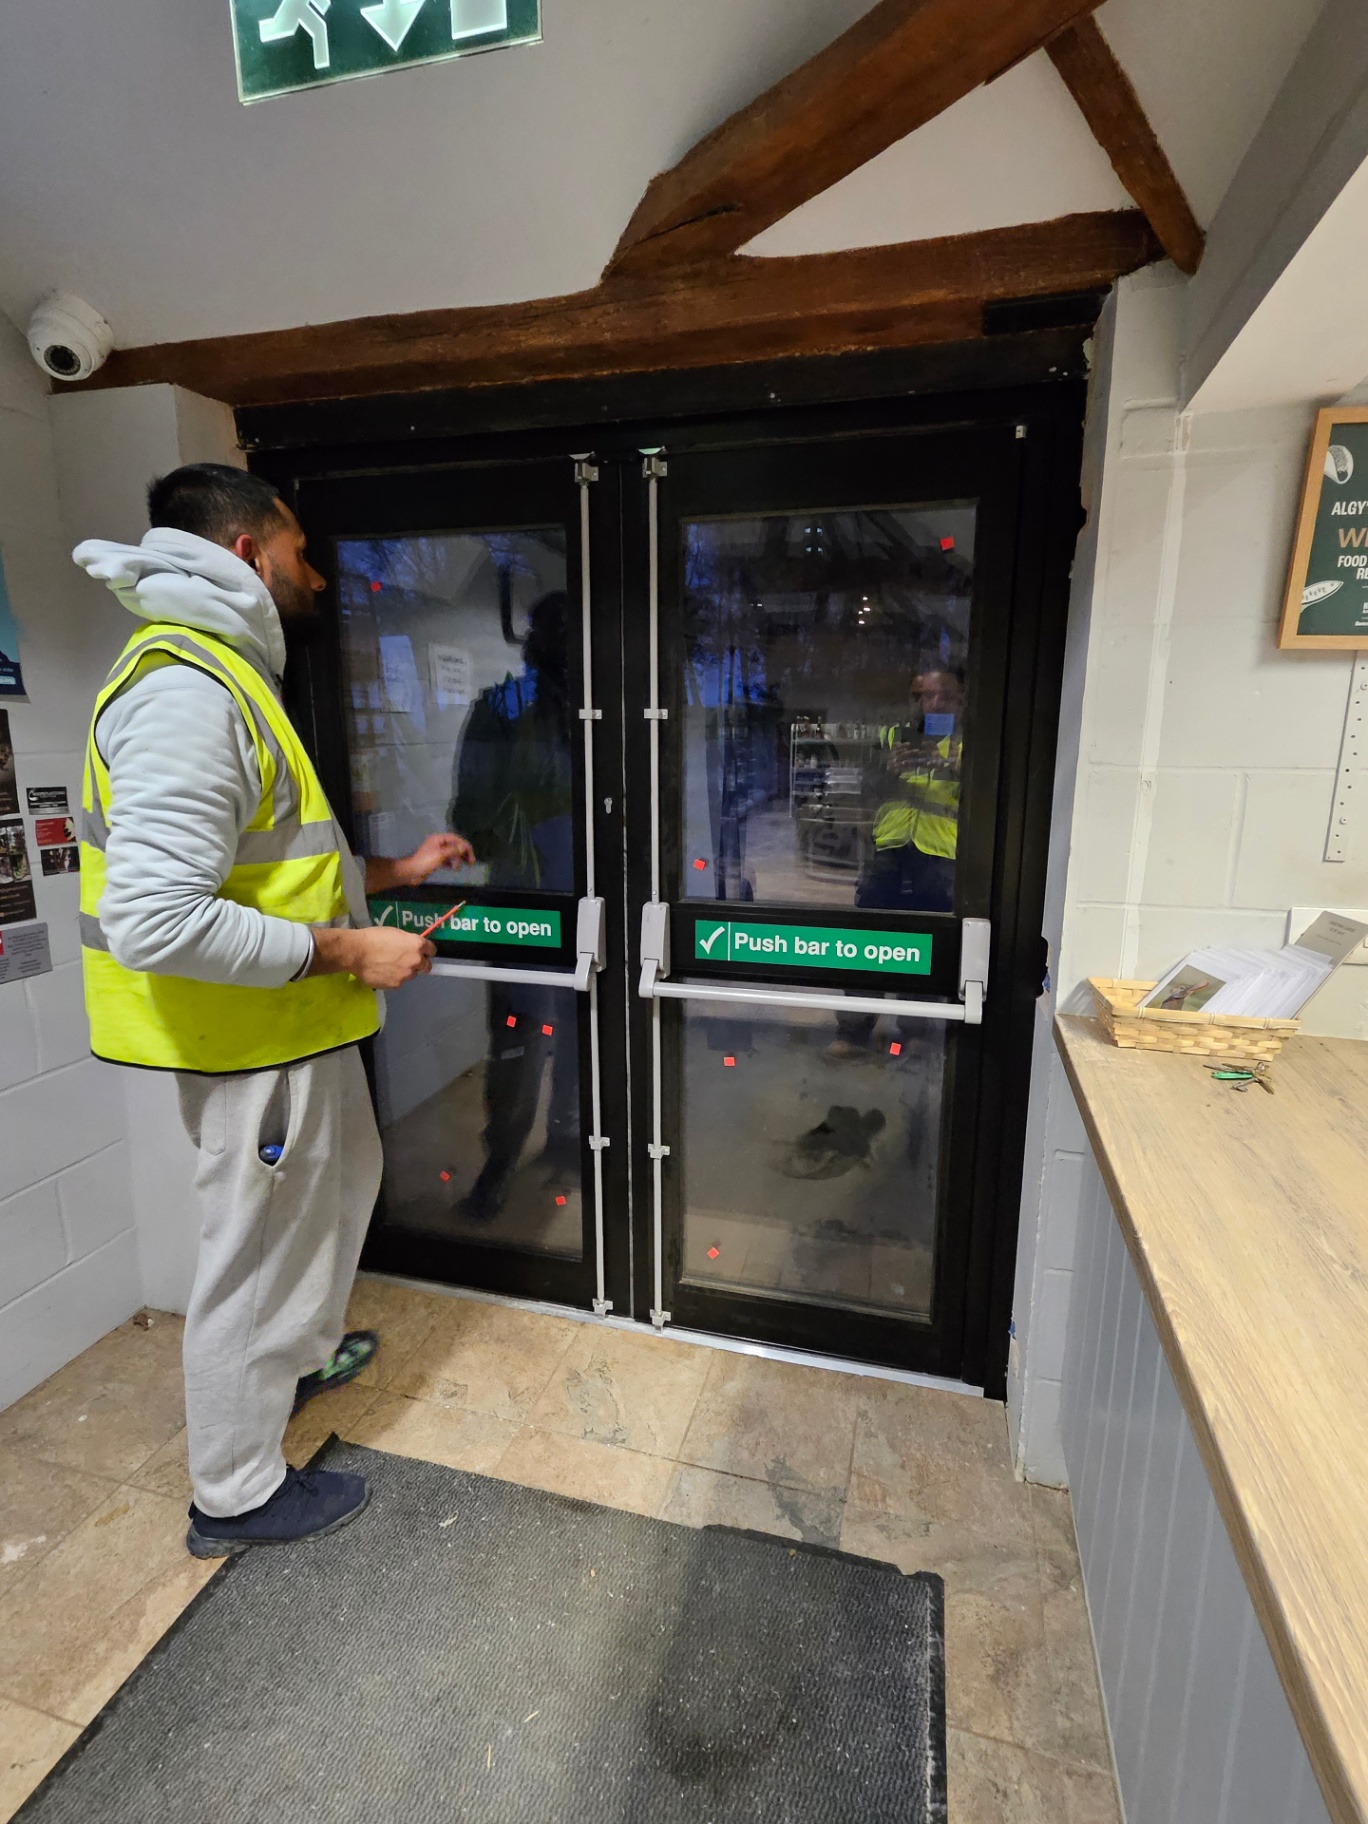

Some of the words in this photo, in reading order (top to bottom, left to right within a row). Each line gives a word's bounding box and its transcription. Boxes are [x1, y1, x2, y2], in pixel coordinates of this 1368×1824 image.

[1337, 555, 1368, 567] FOOD
[402, 910, 445, 929] Push
[450, 914, 479, 931] bar
[483, 917, 501, 933] to
[507, 921, 552, 938] open
[735, 932, 787, 953] Push
[794, 937, 830, 955] bar
[836, 940, 858, 957] to
[863, 944, 920, 964] open
